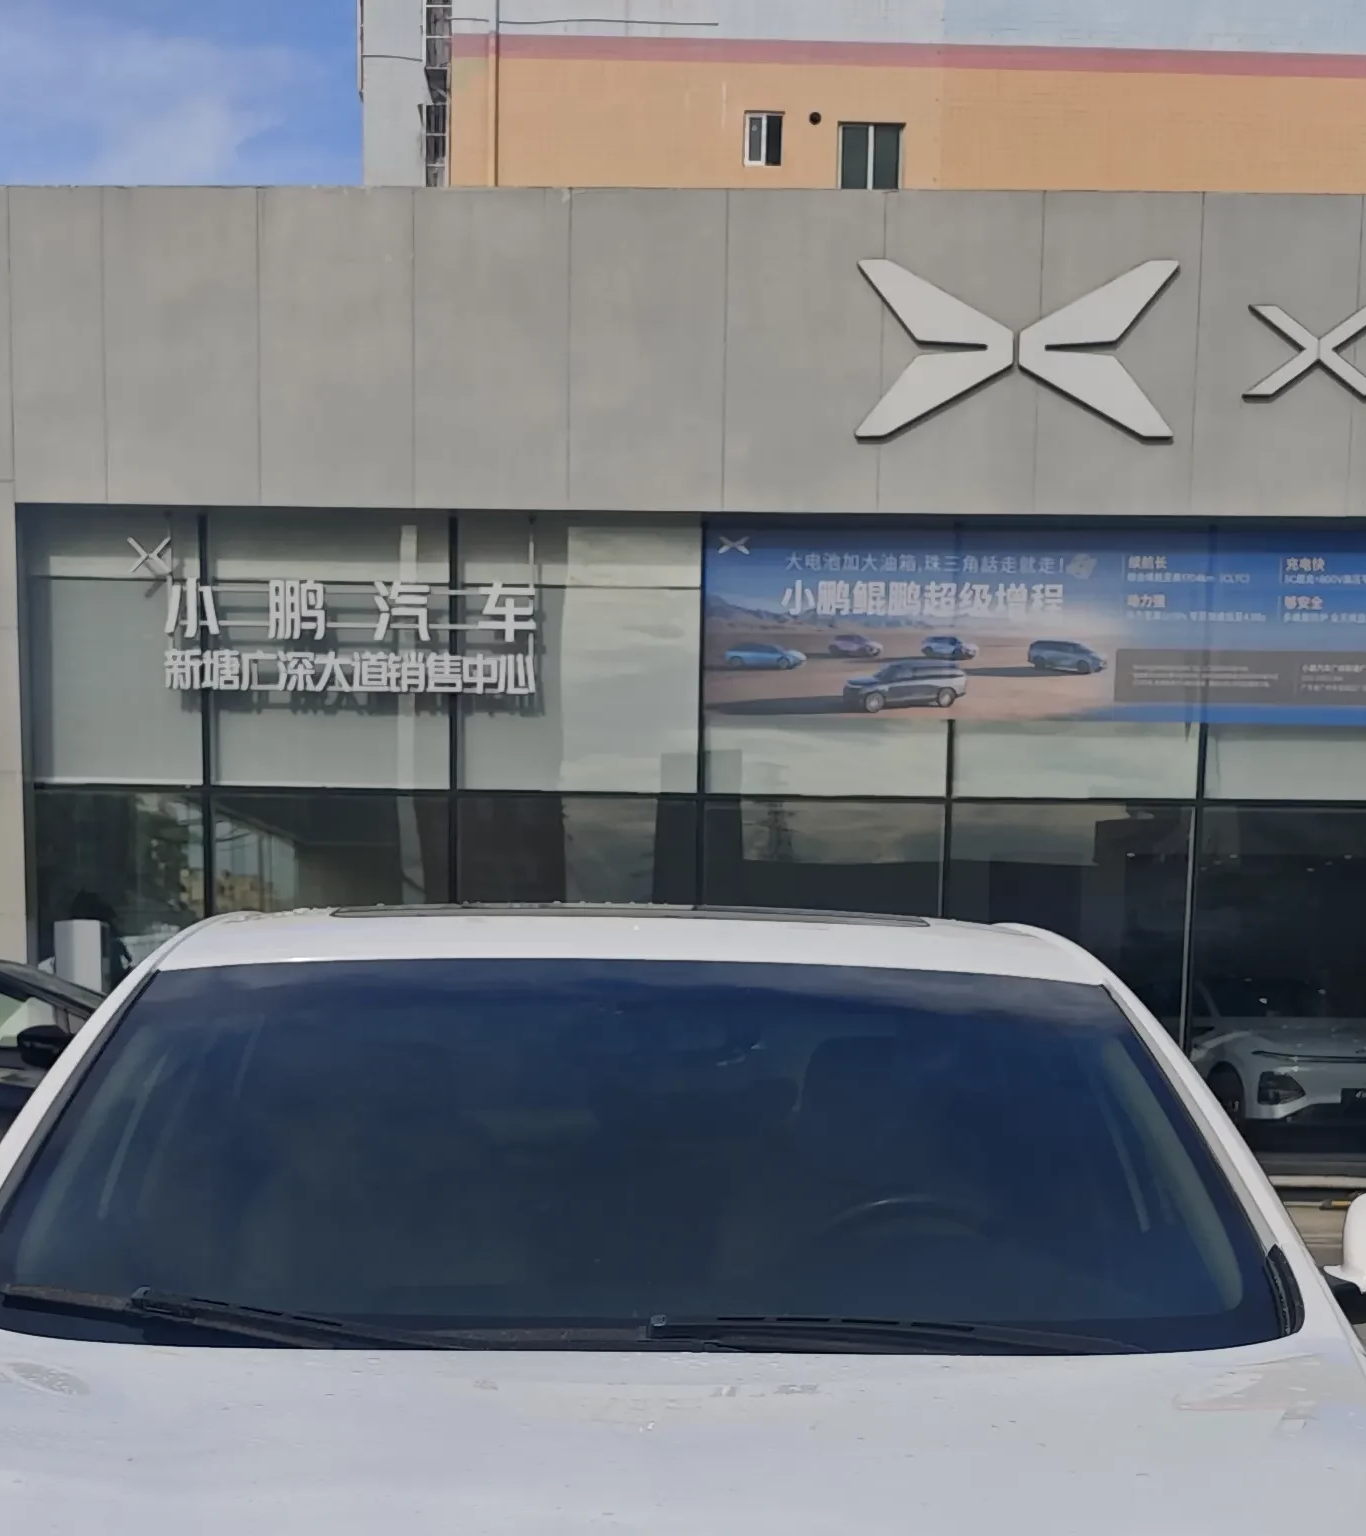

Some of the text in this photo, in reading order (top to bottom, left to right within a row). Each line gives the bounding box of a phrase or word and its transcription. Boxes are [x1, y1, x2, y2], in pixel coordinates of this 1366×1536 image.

[164, 577, 536, 642] 小鹏汽车
[164, 648, 536, 695] 新塘广深大道销售中心
